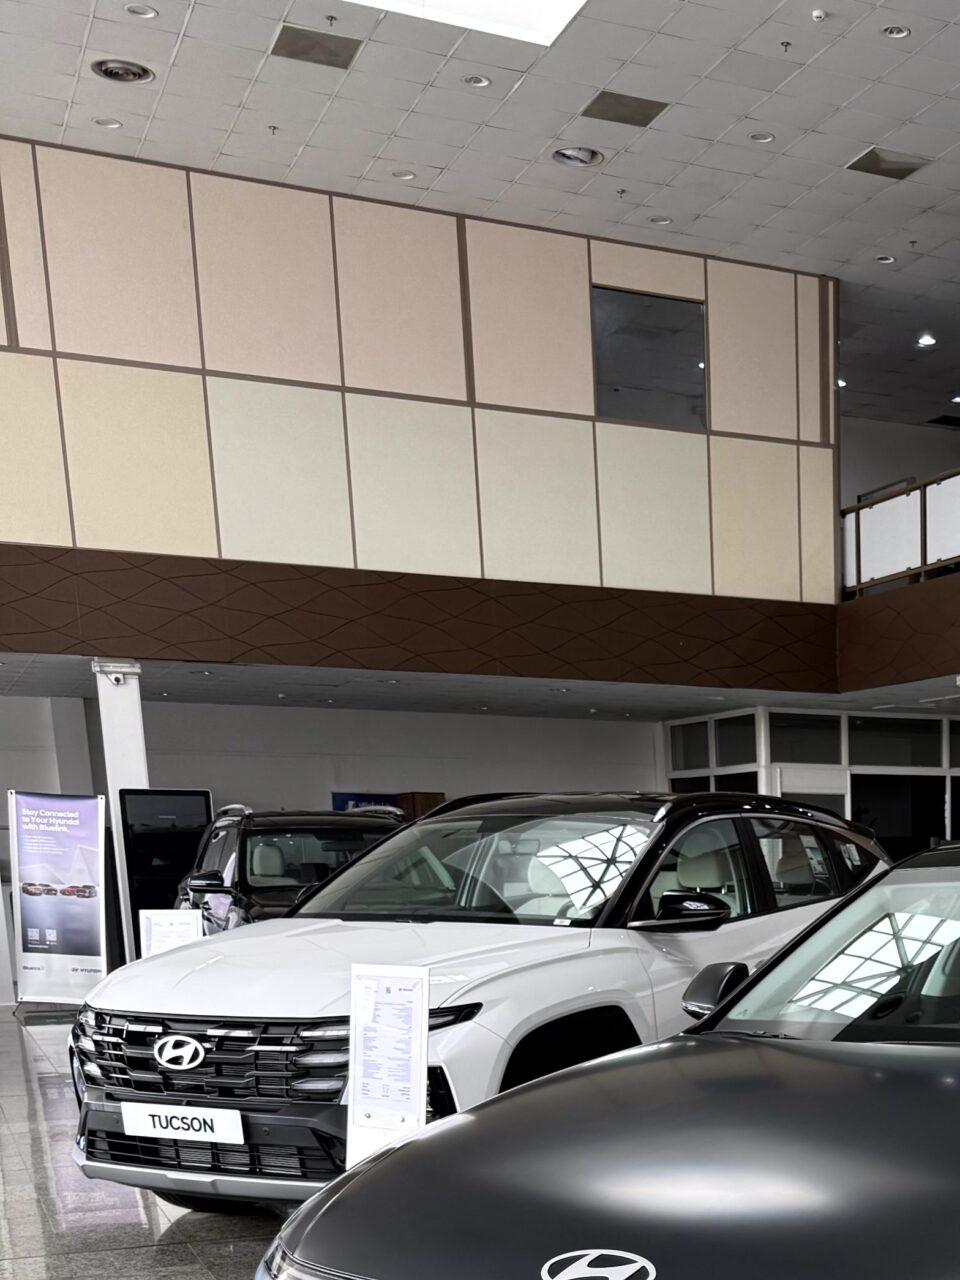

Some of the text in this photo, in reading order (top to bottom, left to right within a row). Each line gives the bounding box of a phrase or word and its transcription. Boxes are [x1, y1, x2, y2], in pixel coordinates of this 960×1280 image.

[22, 808, 79, 818] Stay Connected
[49, 817, 80, 826] Hyundai
[22, 823, 38, 831] with
[148, 1114, 215, 1133] TUCSON
